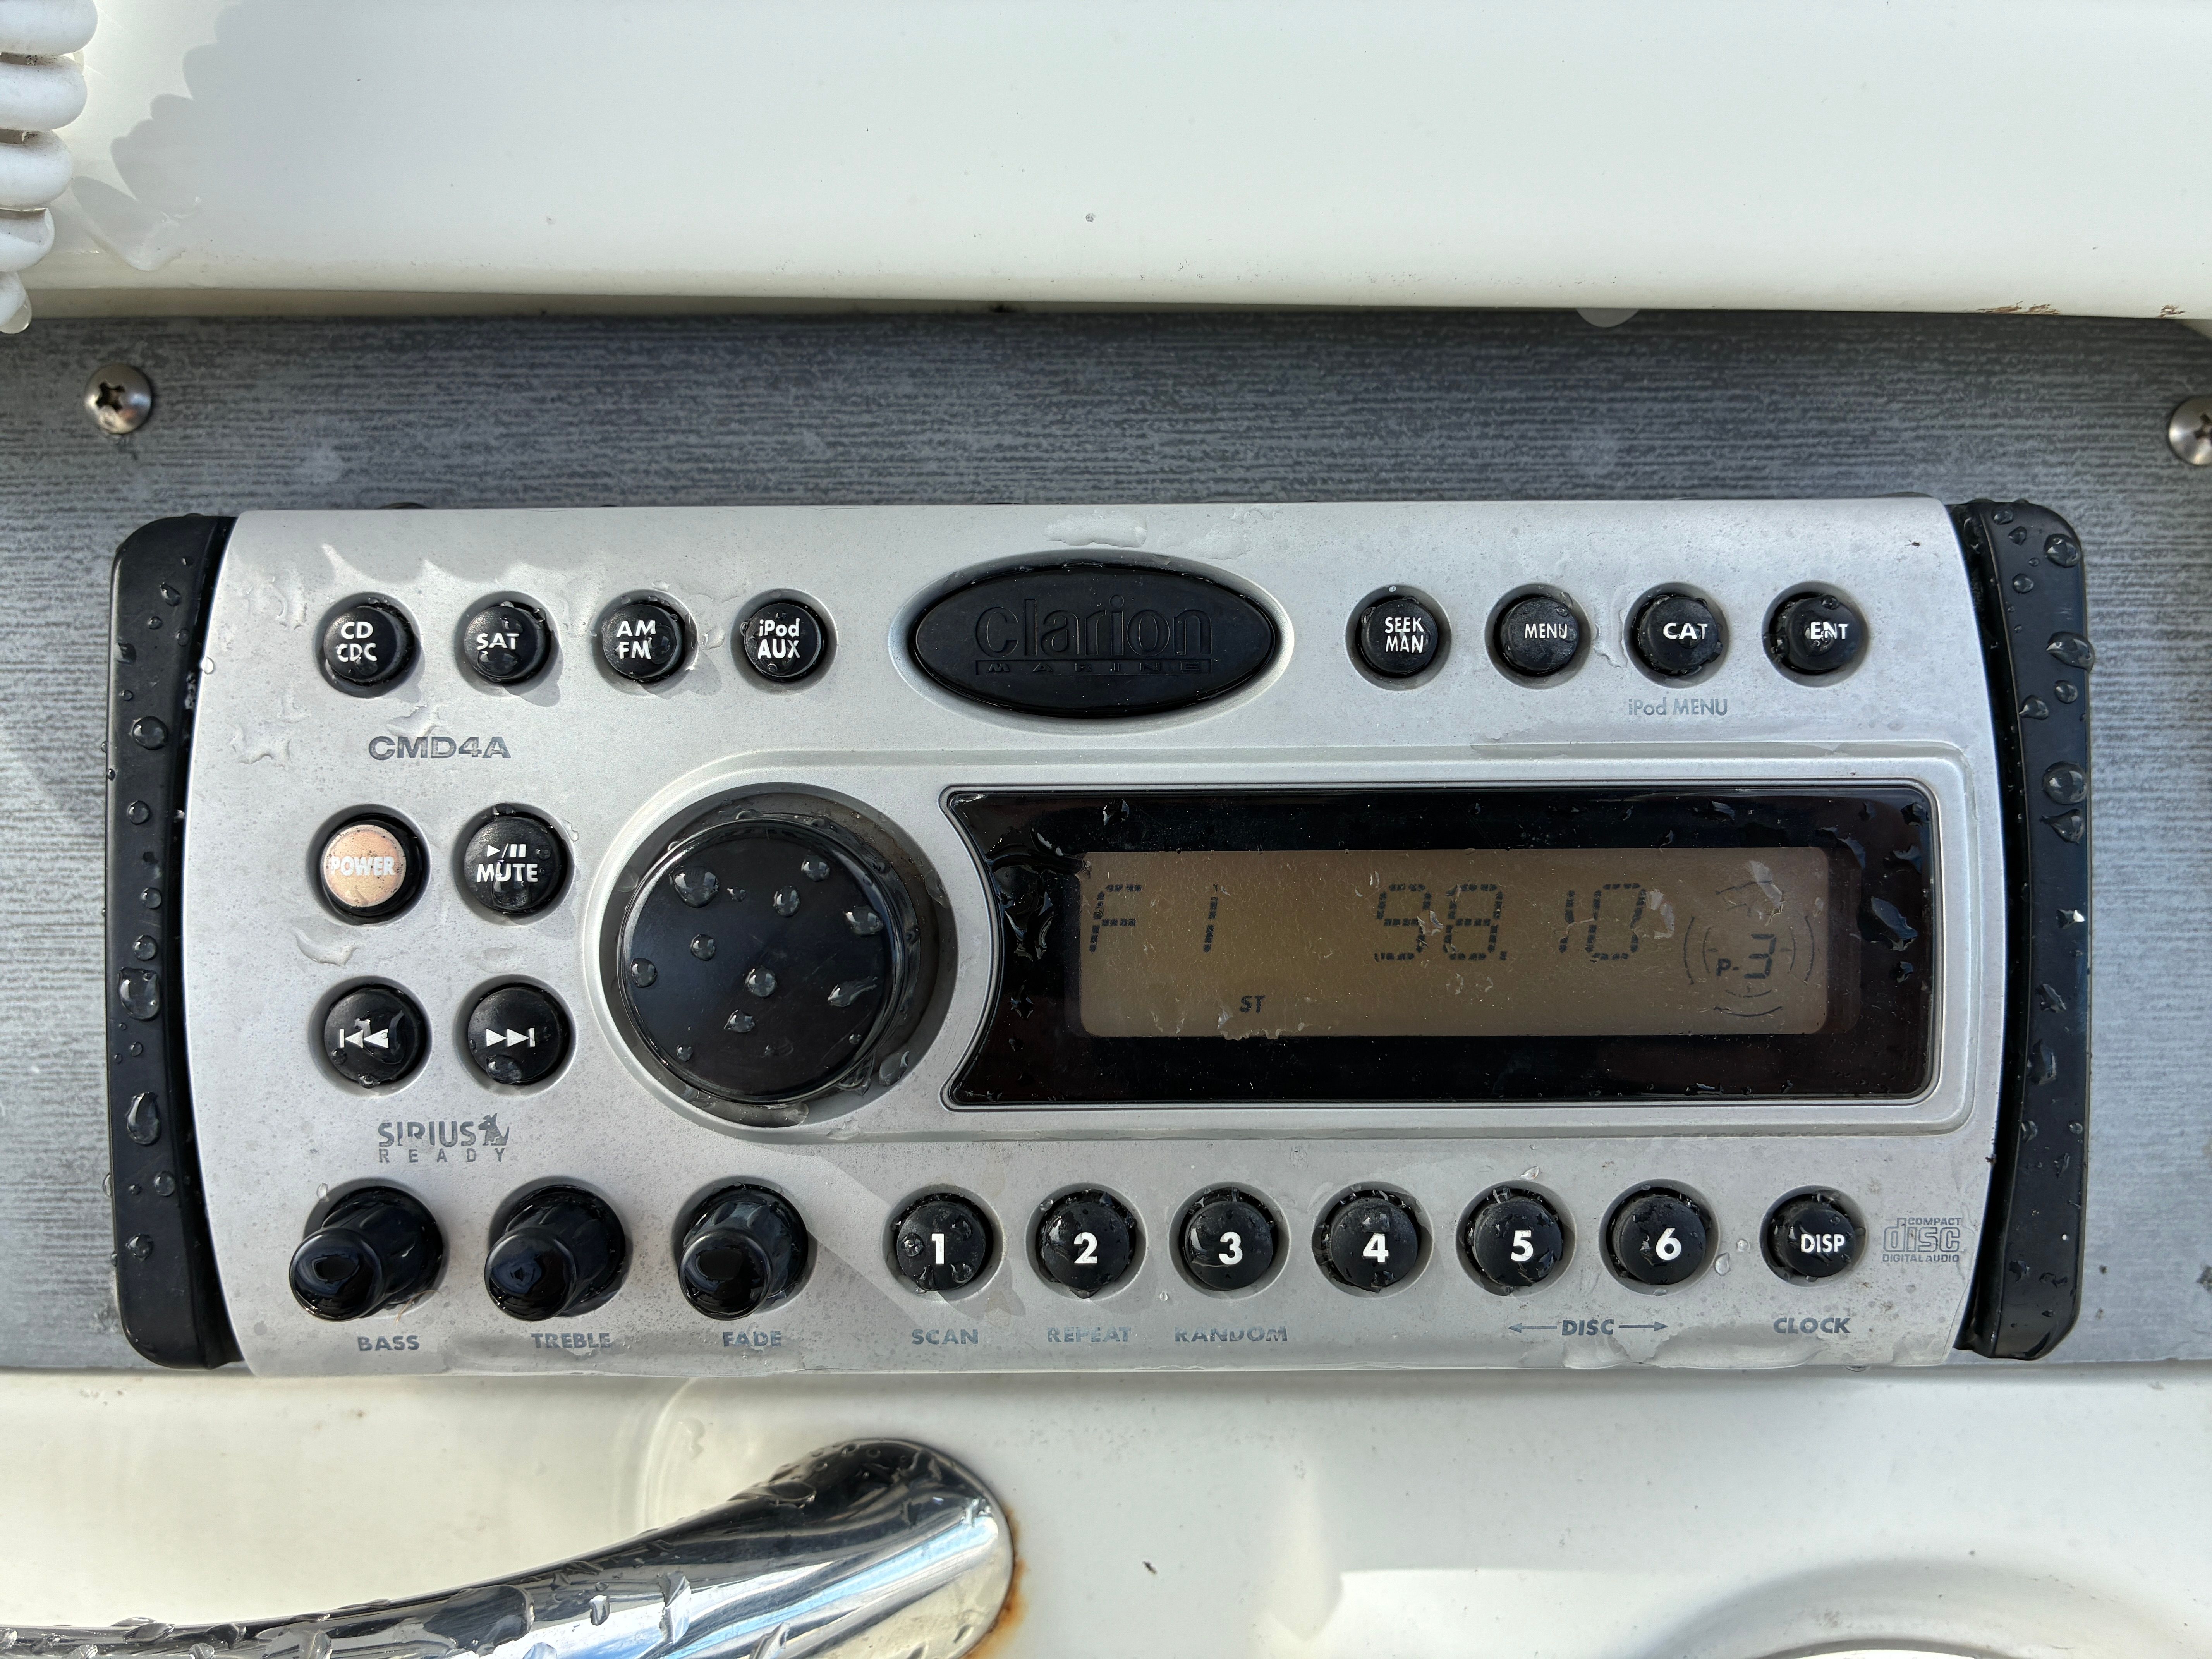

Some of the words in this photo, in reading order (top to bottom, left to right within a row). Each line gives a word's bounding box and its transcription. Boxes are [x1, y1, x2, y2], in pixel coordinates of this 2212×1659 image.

[341, 622, 373, 639] CD
[616, 620, 656, 637] AM
[759, 618, 800, 637] iPod
[1385, 617, 1424, 633] SEEK
[1525, 623, 1567, 639] MENU
[1663, 623, 1708, 640] CAT
[1810, 622, 1848, 640] ENT
[476, 633, 520, 650] SAT
[619, 640, 652, 659] FM
[757, 639, 800, 659] AUX
[1385, 635, 1424, 653] MAN
[337, 643, 378, 662] CDC
[988, 662, 1201, 673] MARINE
[1629, 697, 1666, 716] iPod
[1673, 698, 1728, 716] MENU
[368, 736, 511, 760] CMD4A
[330, 856, 396, 876] POWER
[477, 863, 538, 883] MUTE
[1239, 995, 1265, 1014] ST
[378, 1121, 477, 1147] SIRIUS
[379, 1147, 506, 1163] READY
[1908, 1217, 1961, 1225] COMPACT
[931, 1233, 945, 1264] 1
[1073, 1232, 1098, 1264] 2
[1218, 1232, 1243, 1265] 3
[1362, 1232, 1389, 1263] 4
[1511, 1230, 1534, 1262] 5
[1656, 1228, 1681, 1260] 6
[1801, 1234, 1845, 1252] DISP
[1882, 1254, 1924, 1262] DIGITAL
[1926, 1254, 1960, 1262] AUDIO
[1047, 1326, 1131, 1343] REPEAT
[1175, 1326, 1288, 1342] RANDOM
[1562, 1319, 1614, 1336] DISC
[1773, 1317, 1851, 1334] CLOCK
[357, 1335, 419, 1352] BASS
[531, 1333, 611, 1349] TREBLE
[723, 1331, 782, 1347] FADE
[912, 1329, 979, 1345] SCAN
